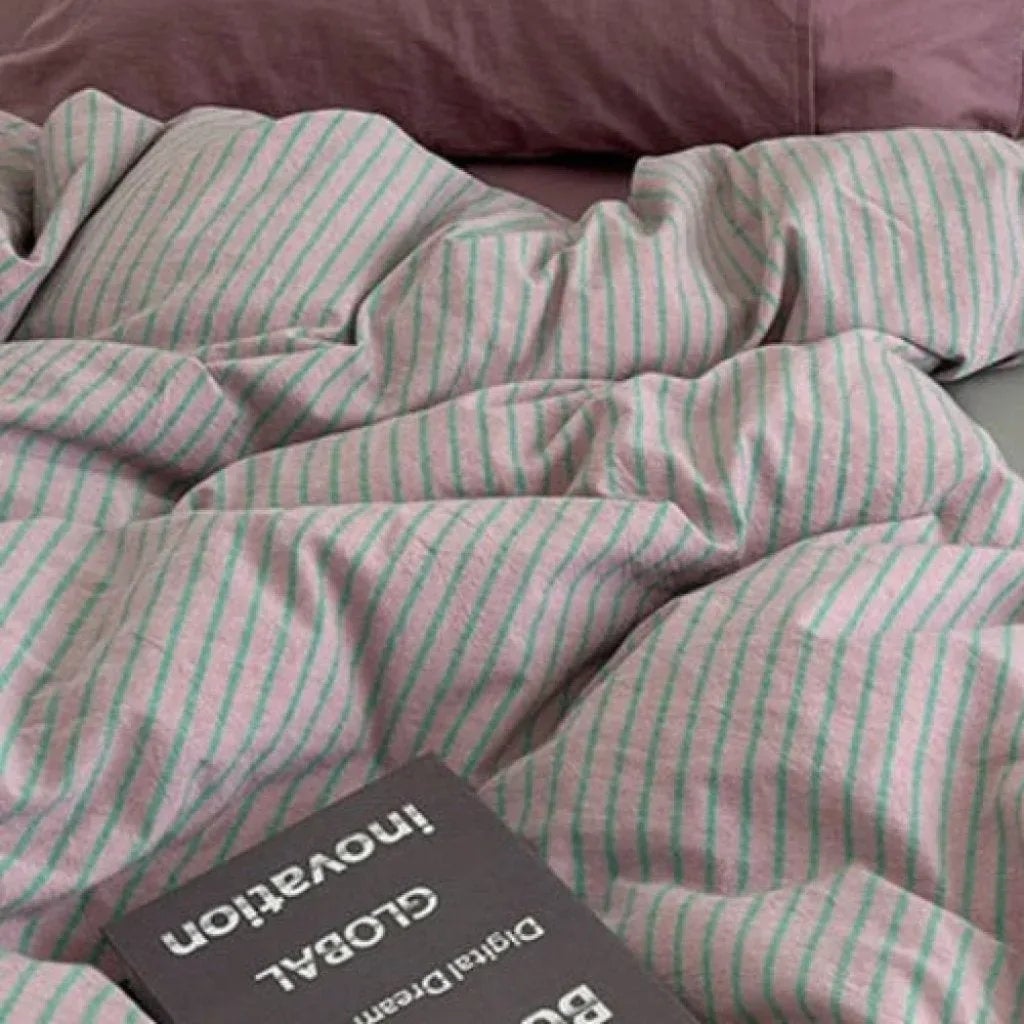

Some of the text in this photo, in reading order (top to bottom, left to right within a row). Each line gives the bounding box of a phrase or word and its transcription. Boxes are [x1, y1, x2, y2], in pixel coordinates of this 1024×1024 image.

[161, 803, 436, 956] inovation
[254, 886, 439, 992] GLOBAL
[446, 915, 545, 982] Digital
